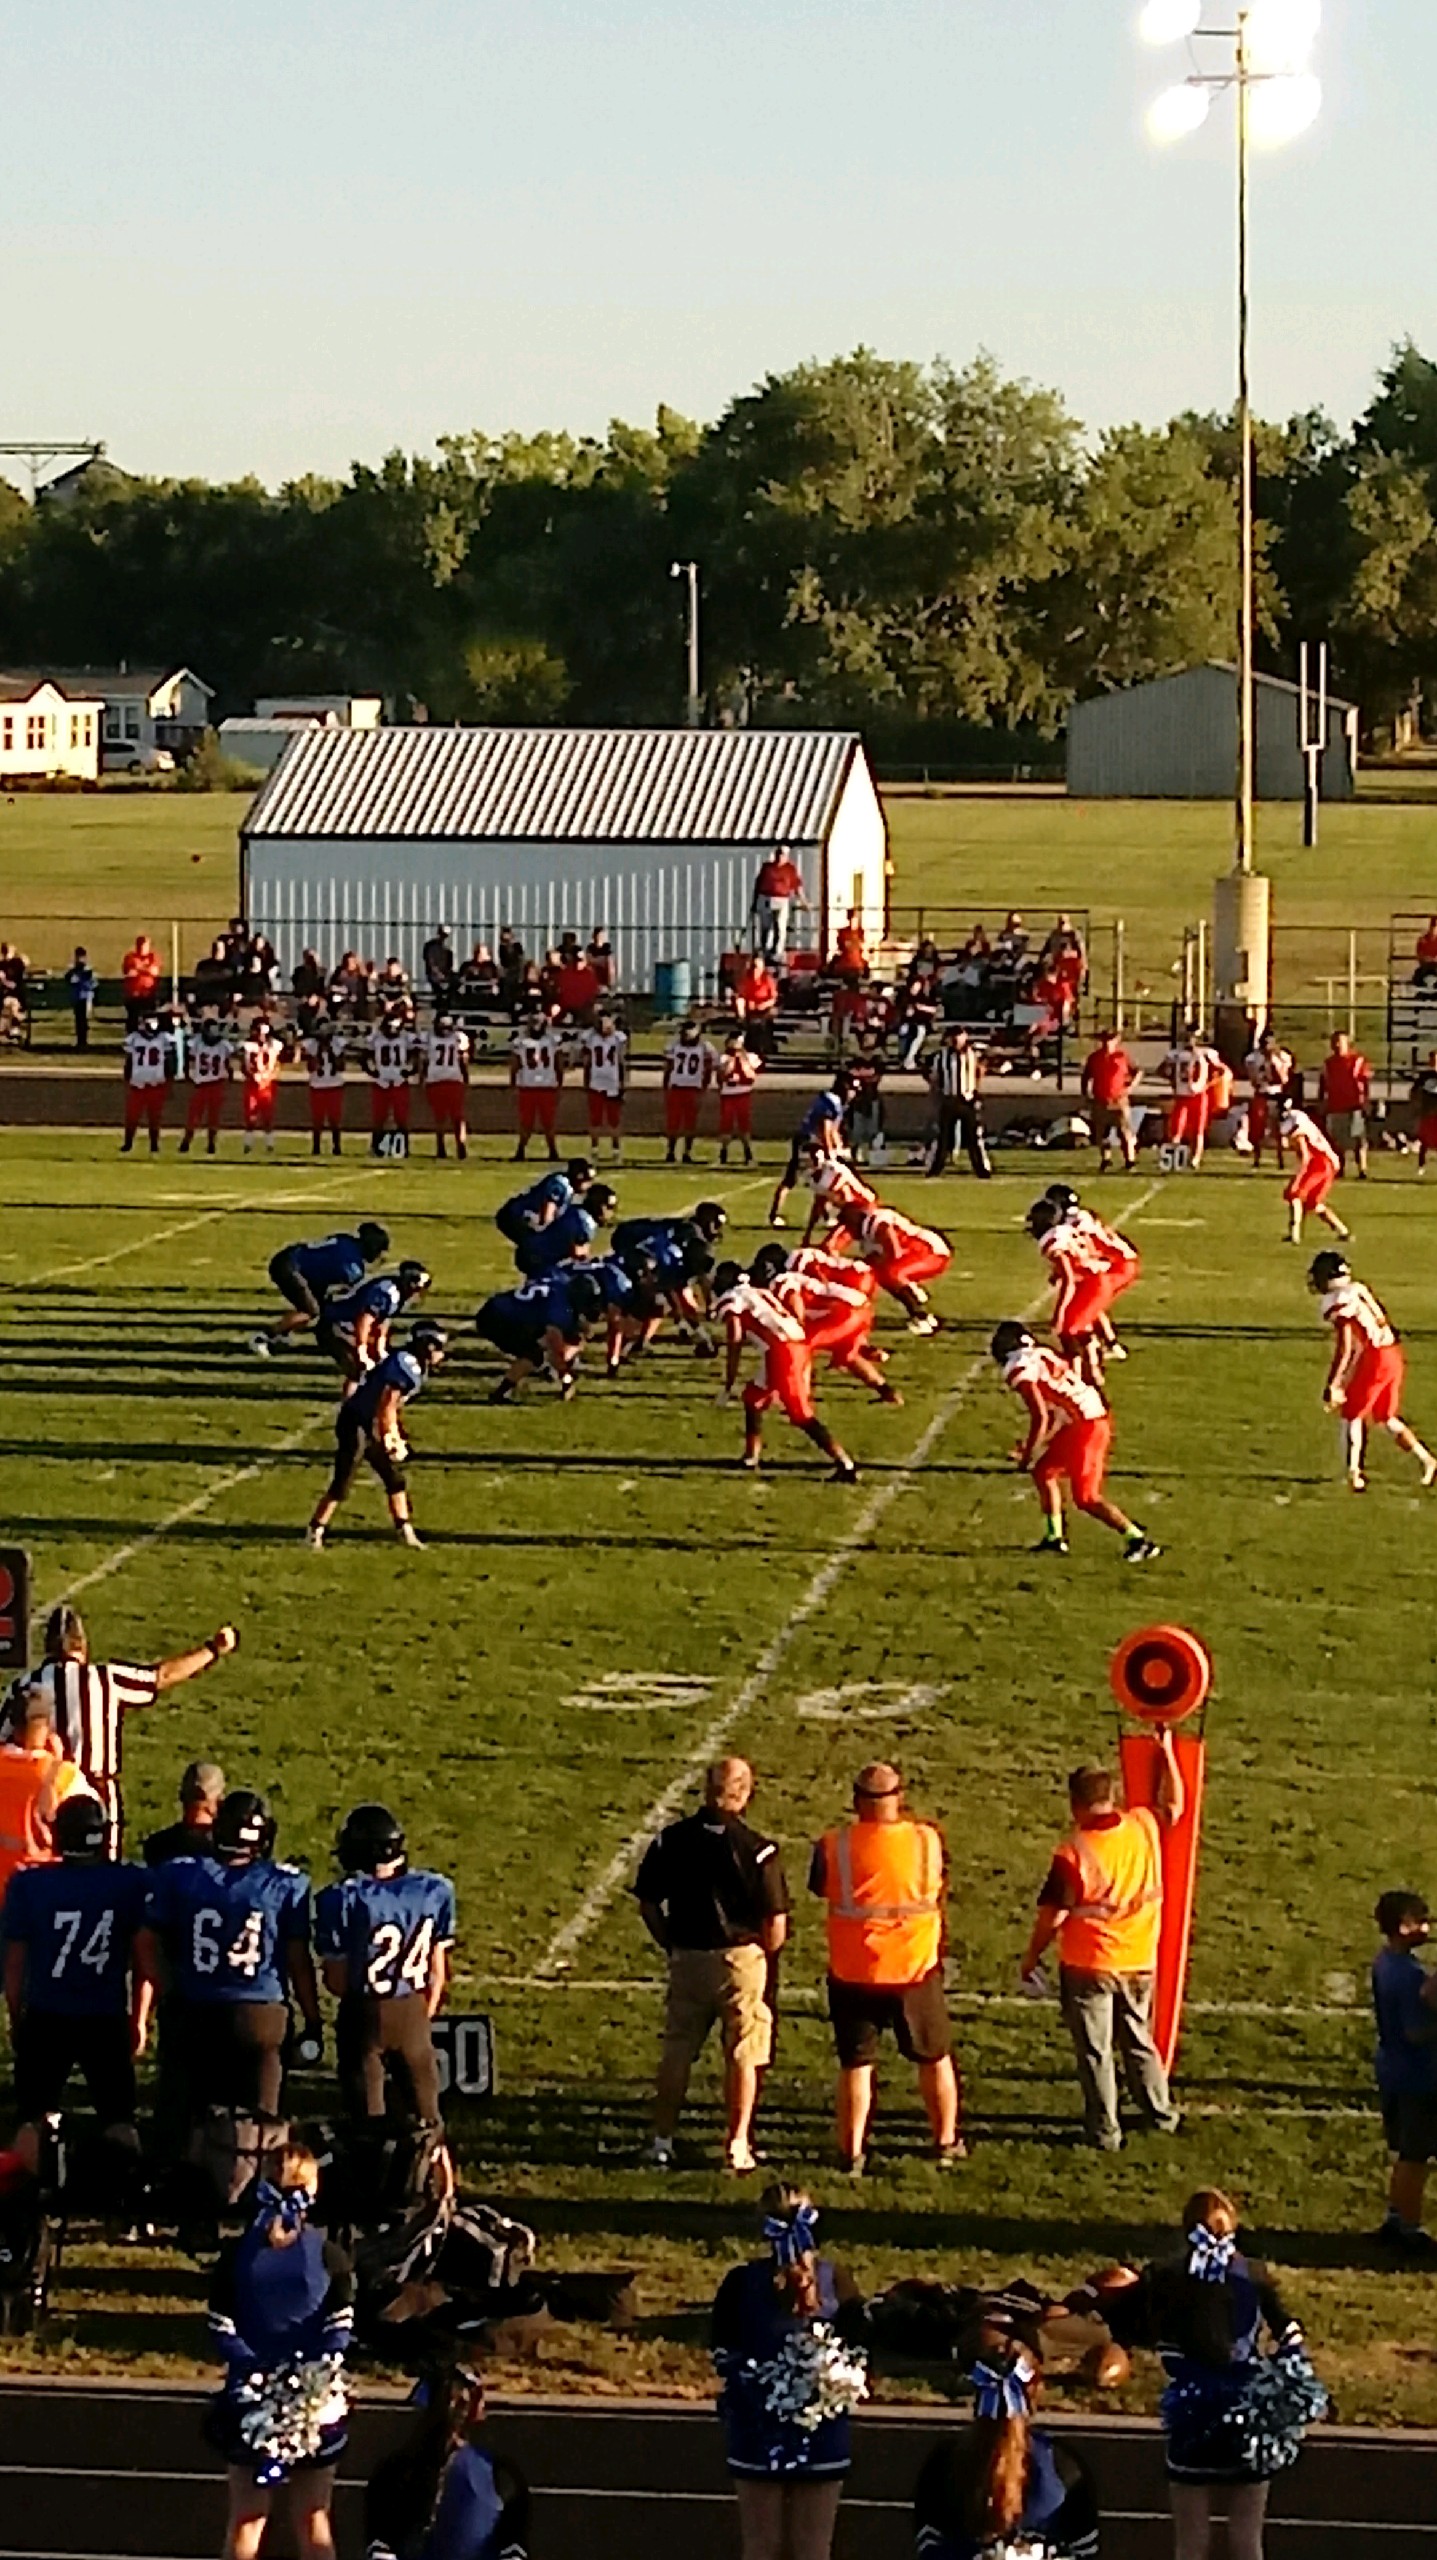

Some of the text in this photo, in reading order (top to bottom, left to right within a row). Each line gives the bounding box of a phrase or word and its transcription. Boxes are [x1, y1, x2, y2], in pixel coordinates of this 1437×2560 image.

[379, 1132, 406, 1158] 40
[1159, 1144, 1190, 1170] 50
[52, 1909, 114, 1978] 74
[193, 1908, 264, 1976] 64
[368, 1917, 435, 1995] 24
